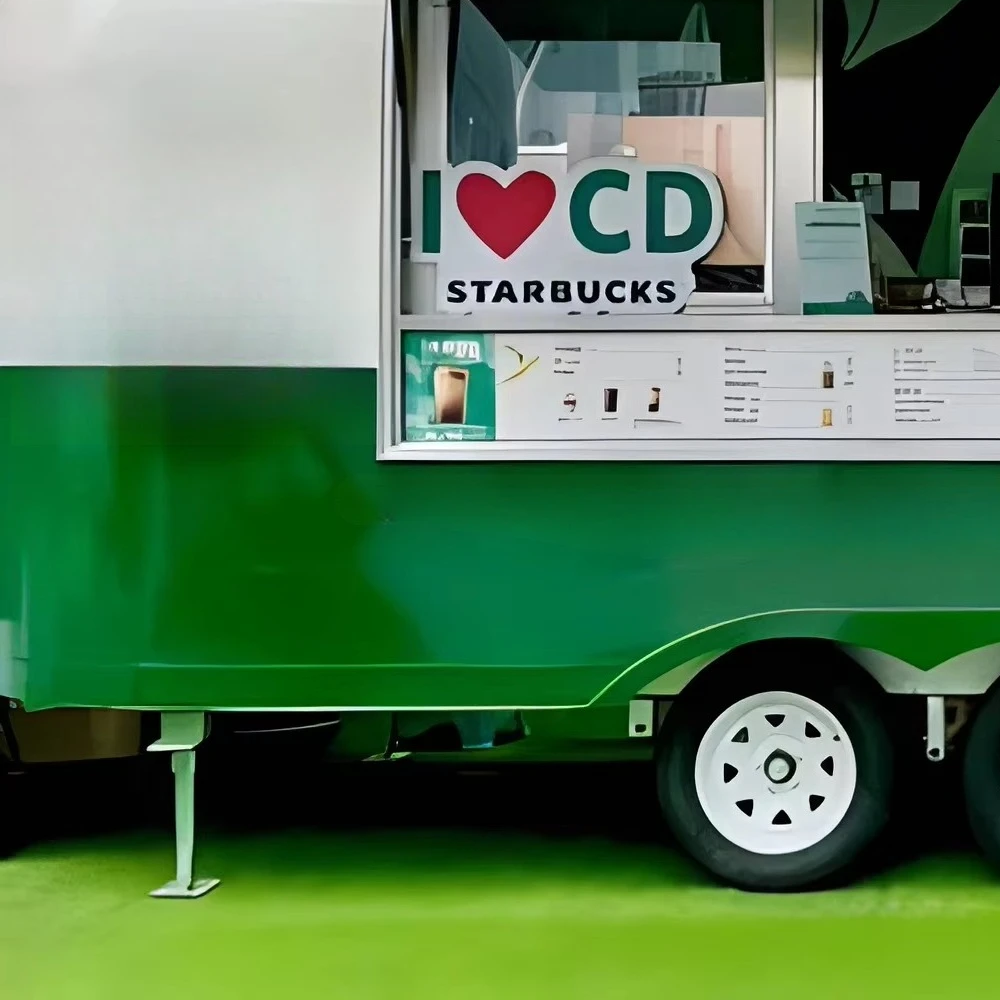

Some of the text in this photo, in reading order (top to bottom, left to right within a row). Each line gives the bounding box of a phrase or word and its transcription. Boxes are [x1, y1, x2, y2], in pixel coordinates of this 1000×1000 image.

[422, 168, 713, 254] I CD
[447, 279, 677, 303] STARBUCKS
